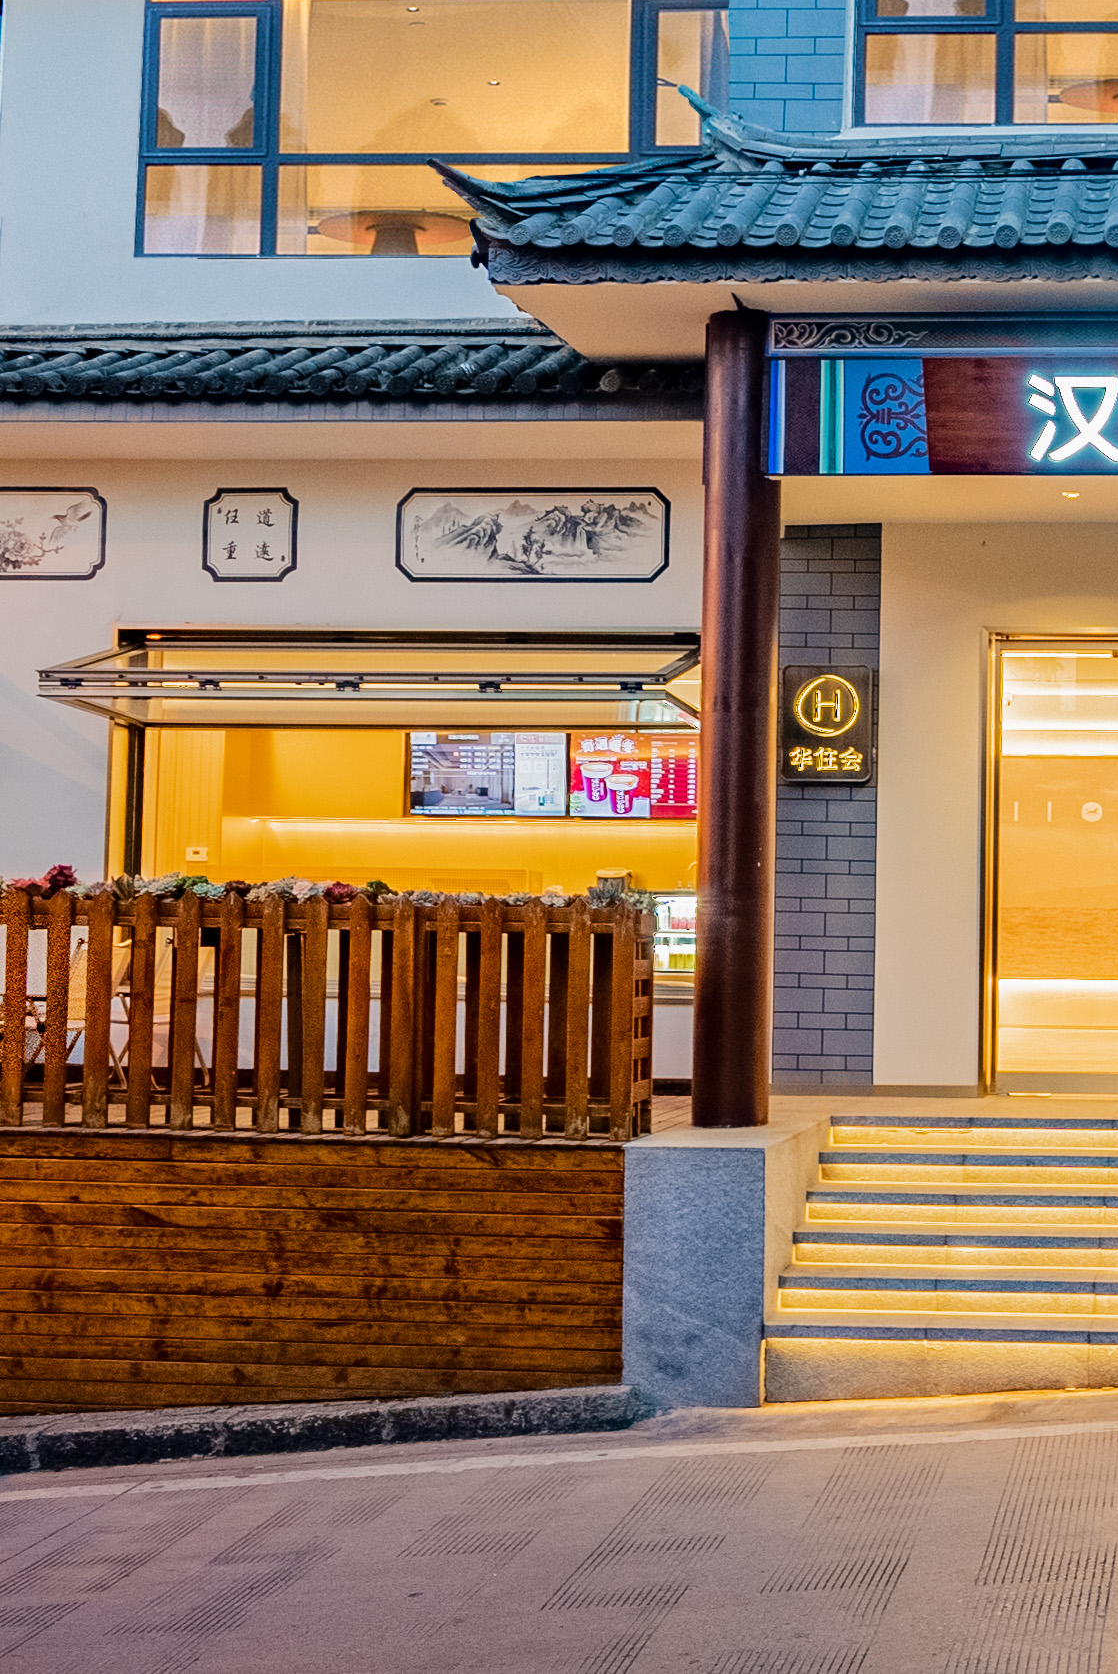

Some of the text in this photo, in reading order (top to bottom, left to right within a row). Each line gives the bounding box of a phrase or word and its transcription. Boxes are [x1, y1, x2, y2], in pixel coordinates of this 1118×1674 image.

[813, 689, 841, 723] H
[789, 746, 863, 772] 华住会
